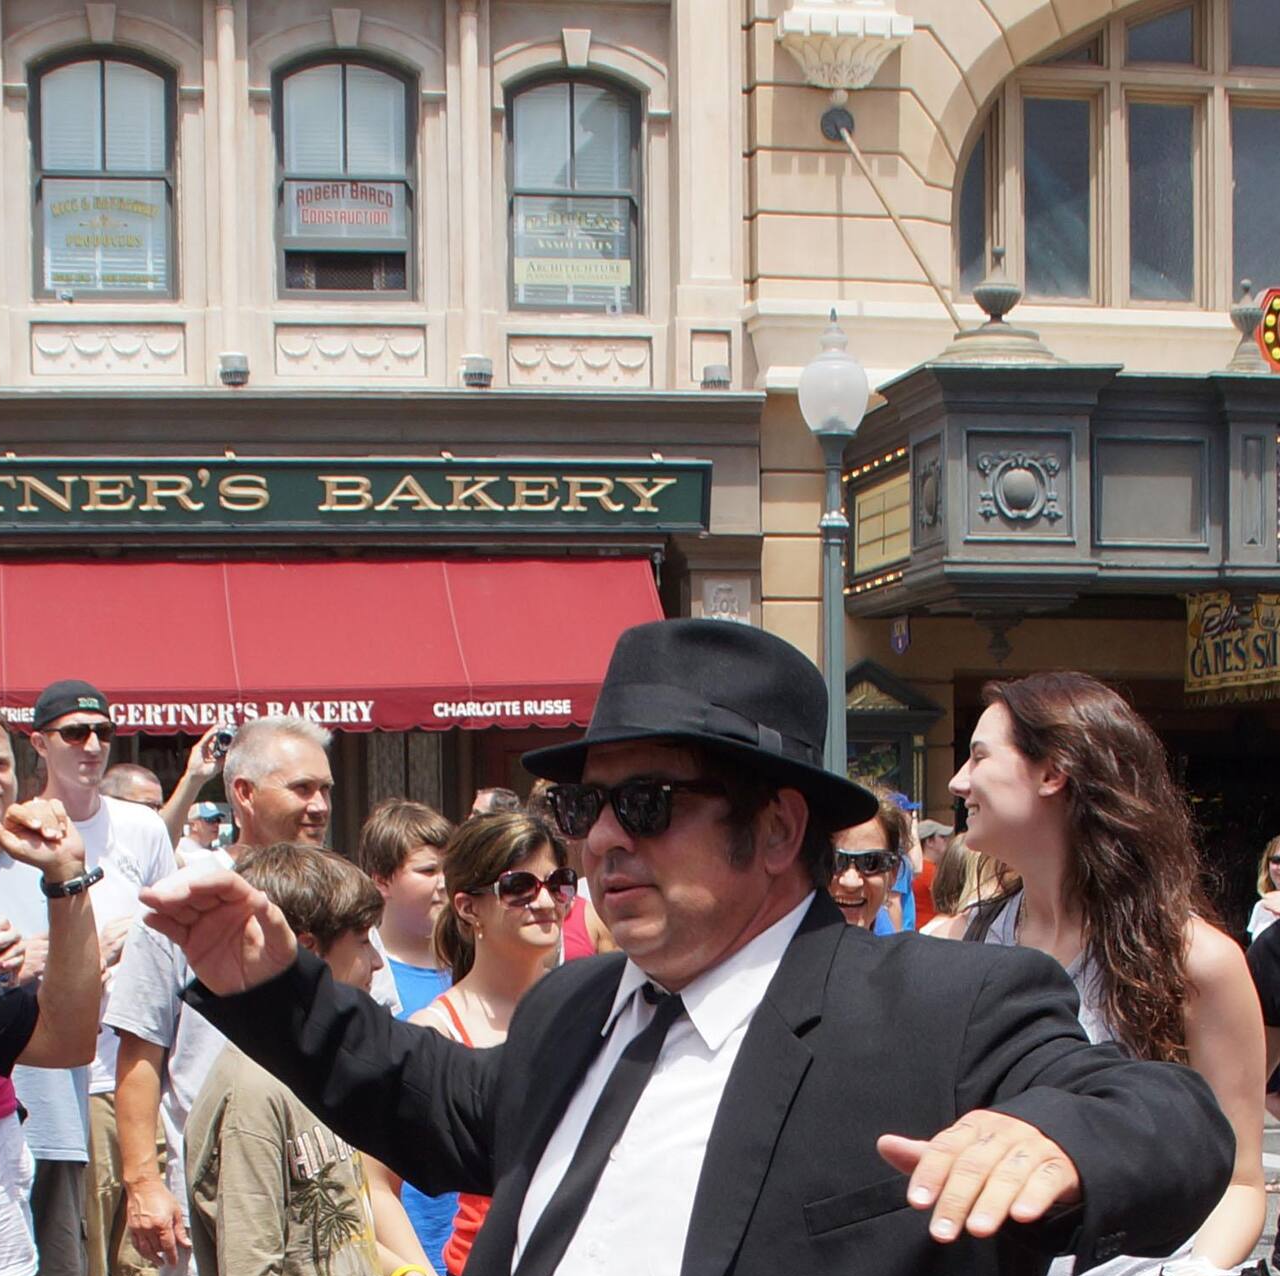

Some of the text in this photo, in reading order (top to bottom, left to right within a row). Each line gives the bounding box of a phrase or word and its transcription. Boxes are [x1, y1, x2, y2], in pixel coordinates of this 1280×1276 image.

[296, 183, 347, 207] ROBERT
[301, 208, 389, 224] CONSTRUCTION
[317, 474, 677, 512] BAKERY
[108, 702, 258, 726] GERTNER'S
[266, 700, 374, 724] BAKERY
[433, 700, 571, 717] CHARLOTTE RUSSE
